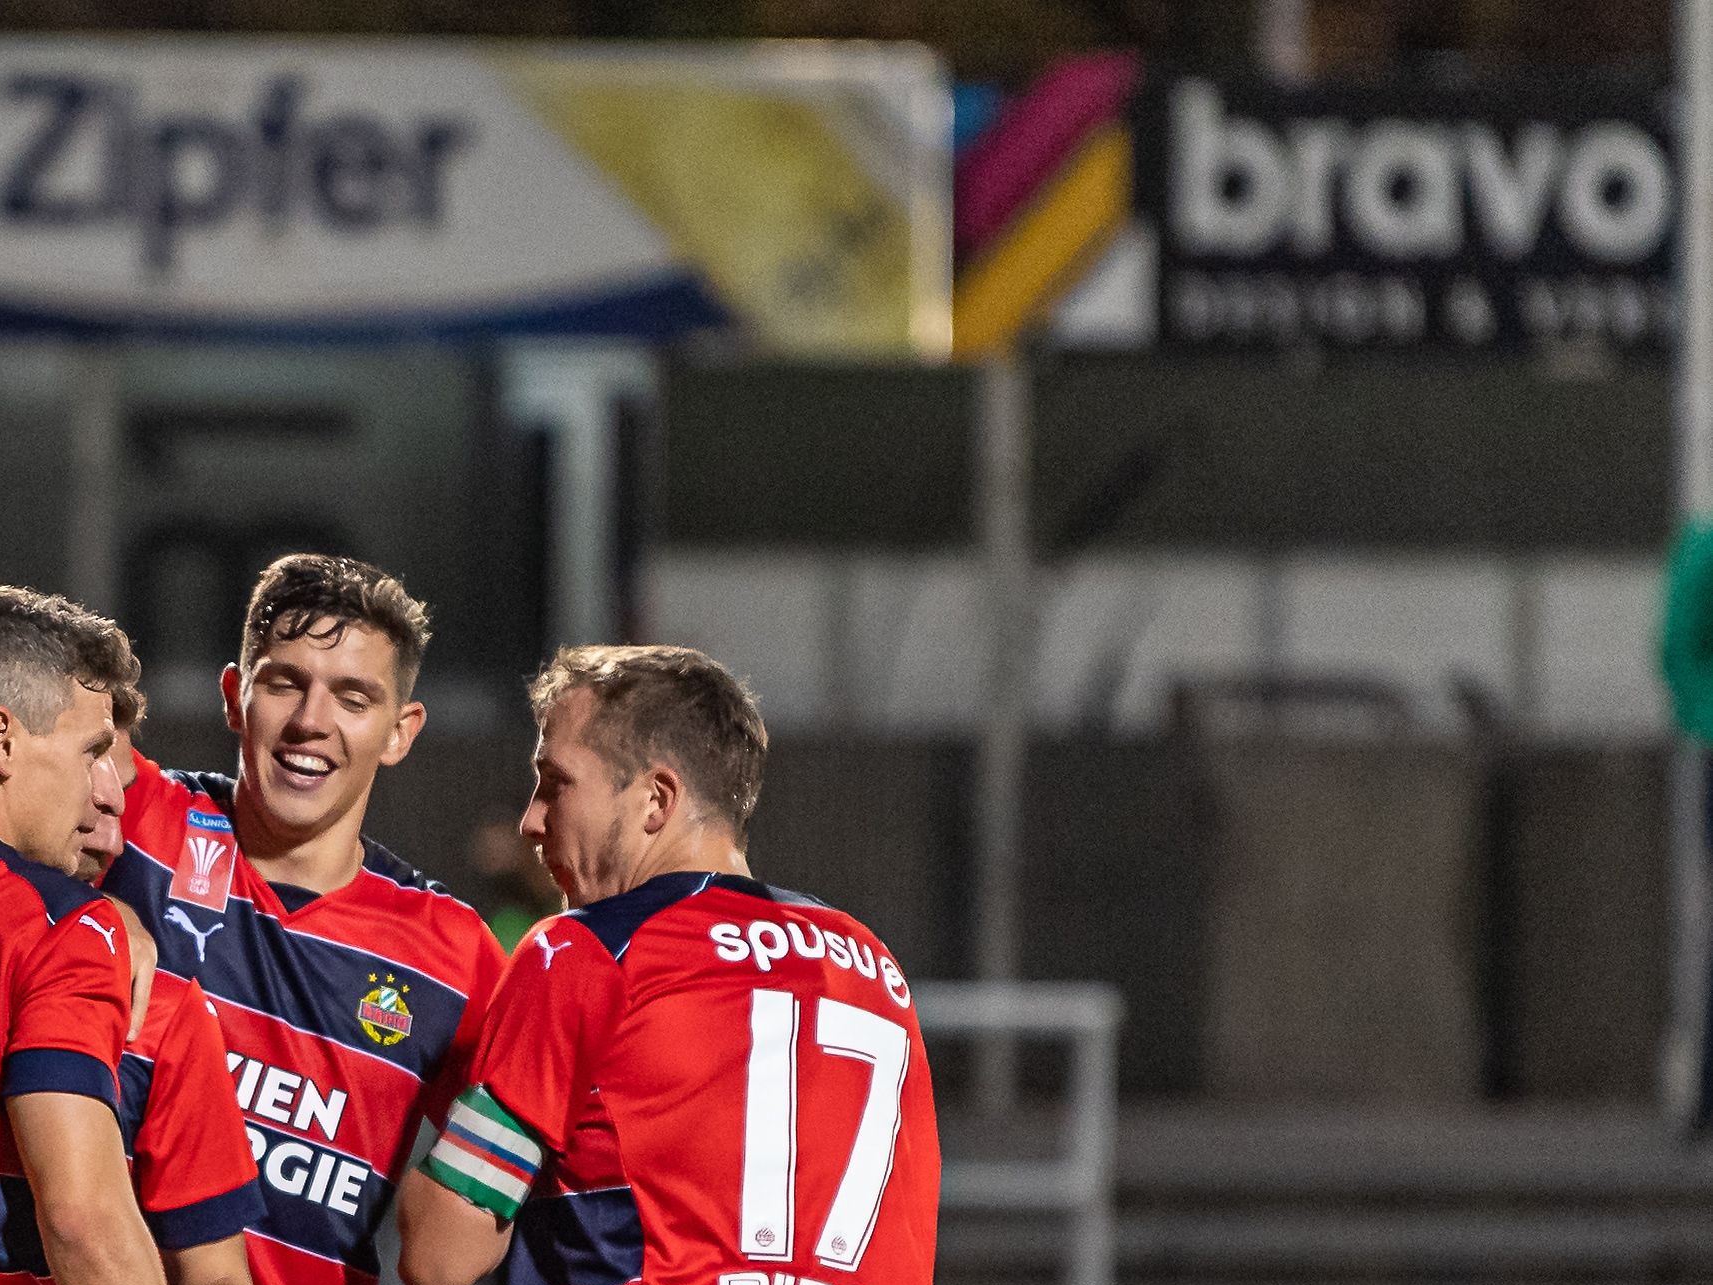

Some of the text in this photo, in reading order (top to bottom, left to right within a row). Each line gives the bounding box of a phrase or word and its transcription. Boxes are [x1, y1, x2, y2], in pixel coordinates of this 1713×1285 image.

[1169, 77, 1674, 261] bravo
[226, 1051, 347, 1141] IEN
[740, 988, 911, 1272] 17
